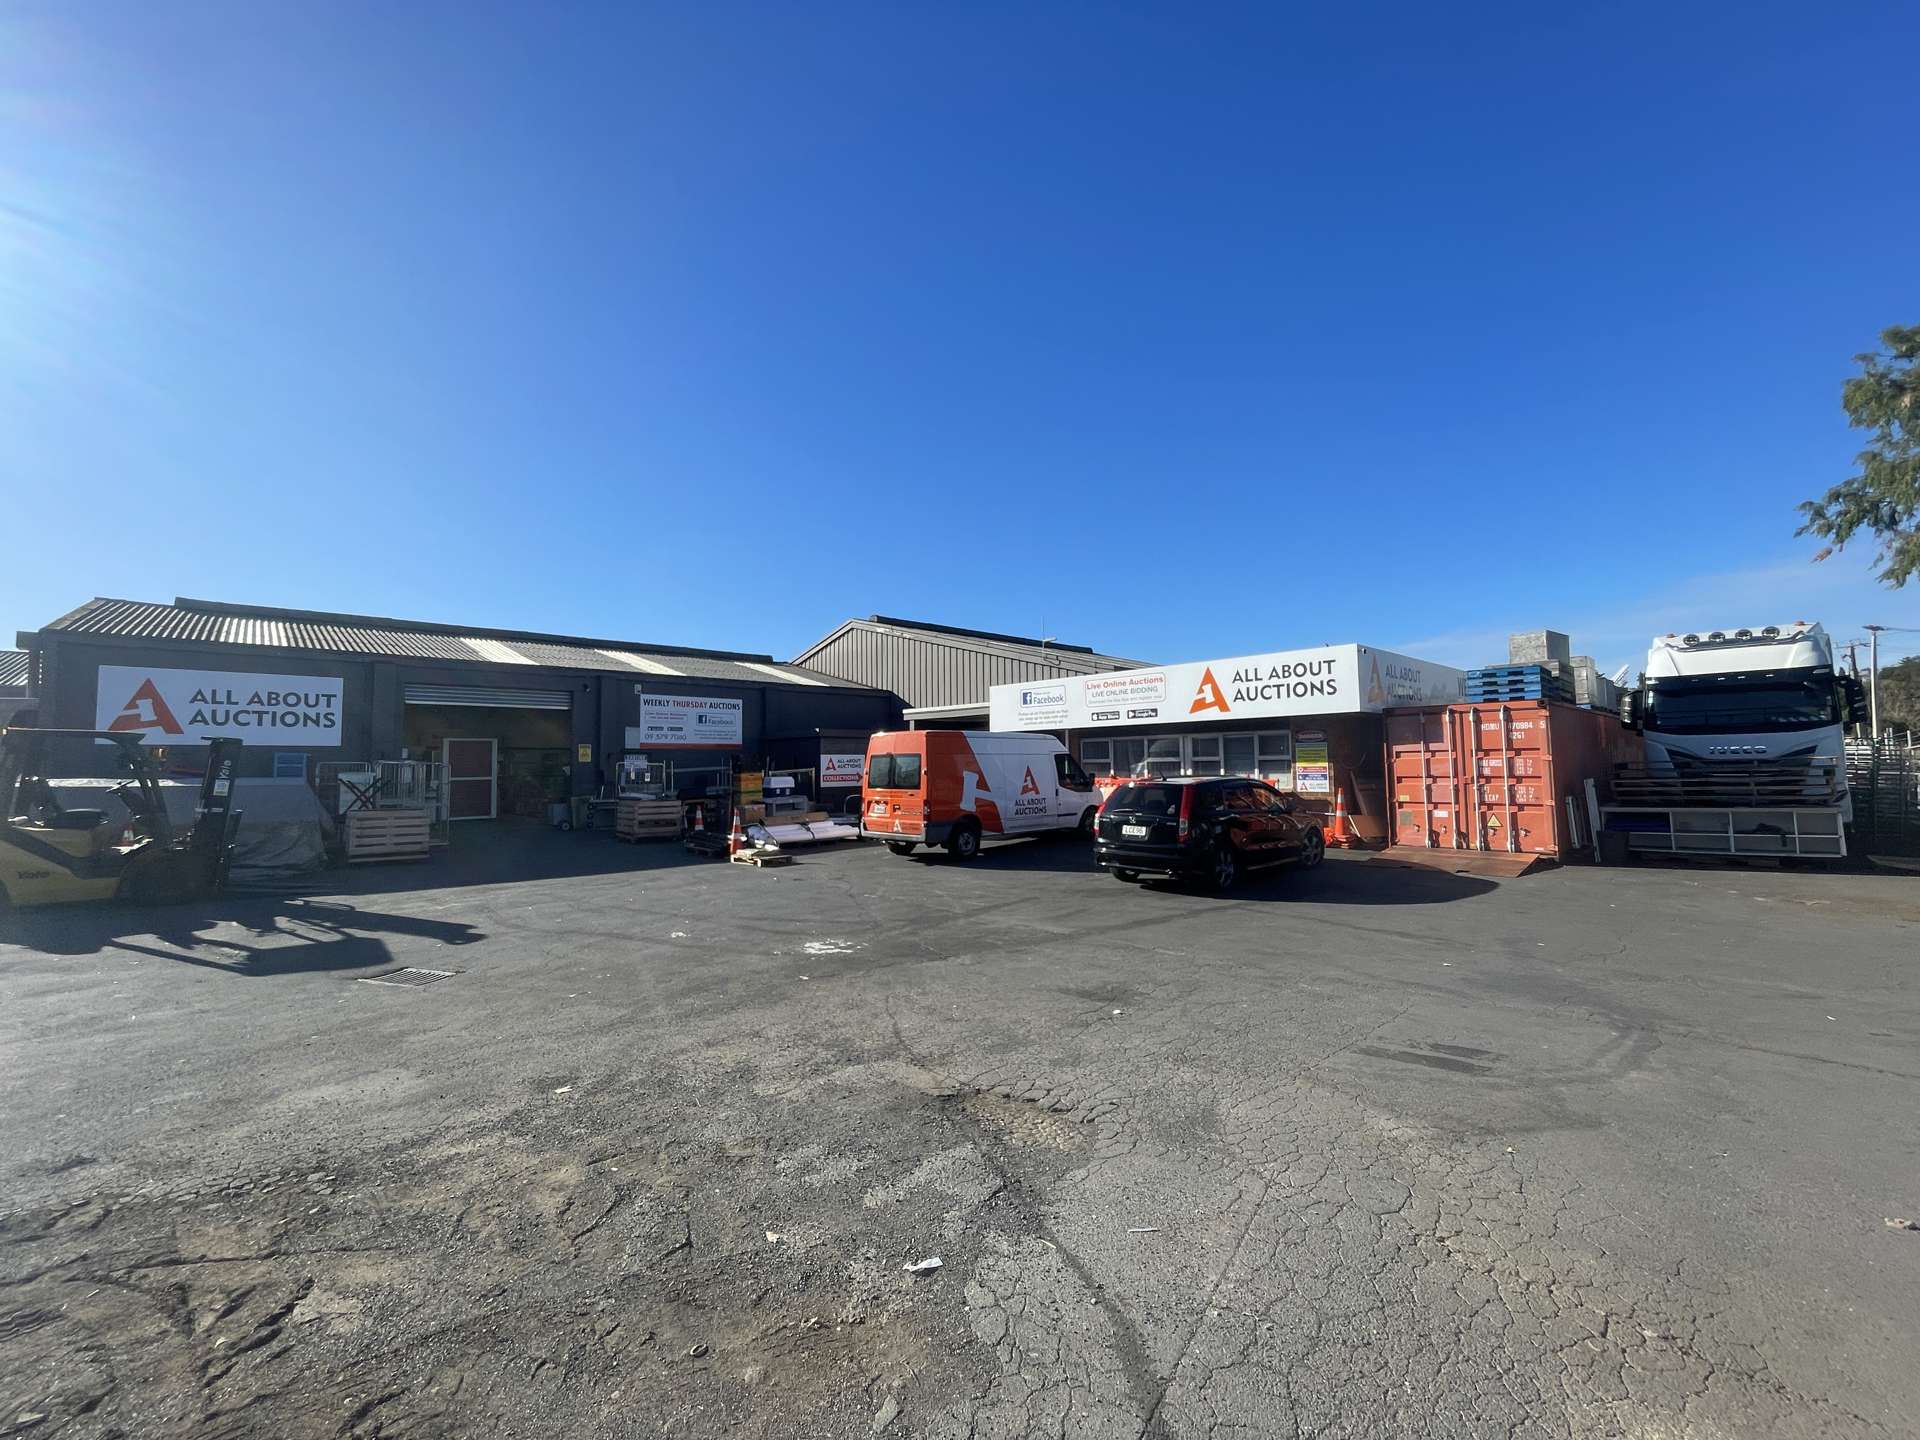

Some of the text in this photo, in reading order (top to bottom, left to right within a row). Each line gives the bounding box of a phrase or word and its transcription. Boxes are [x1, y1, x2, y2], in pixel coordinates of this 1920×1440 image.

[1232, 659, 1336, 684] ALL ABOUT
[1385, 663, 1421, 684] ALL ABOUT
[1102, 680, 1127, 689] Online
[1128, 676, 1163, 686] Auctions
[1106, 688, 1129, 697] ONLINE
[1130, 686, 1158, 695] BIDDING
[1233, 679, 1337, 702] AUCTIONS
[188, 688, 337, 709] ALL ABOUT
[643, 698, 741, 711] WEEKLY THURSDAY AUCTIONS
[1033, 694, 1064, 705] Facebook
[188, 708, 336, 729] AUCTIONS
[1708, 745, 1768, 754] IVECO
[219, 759, 232, 779] Yale
[1014, 797, 1047, 807] ALL ABOUT
[1014, 806, 1047, 816] AUCTIONS
